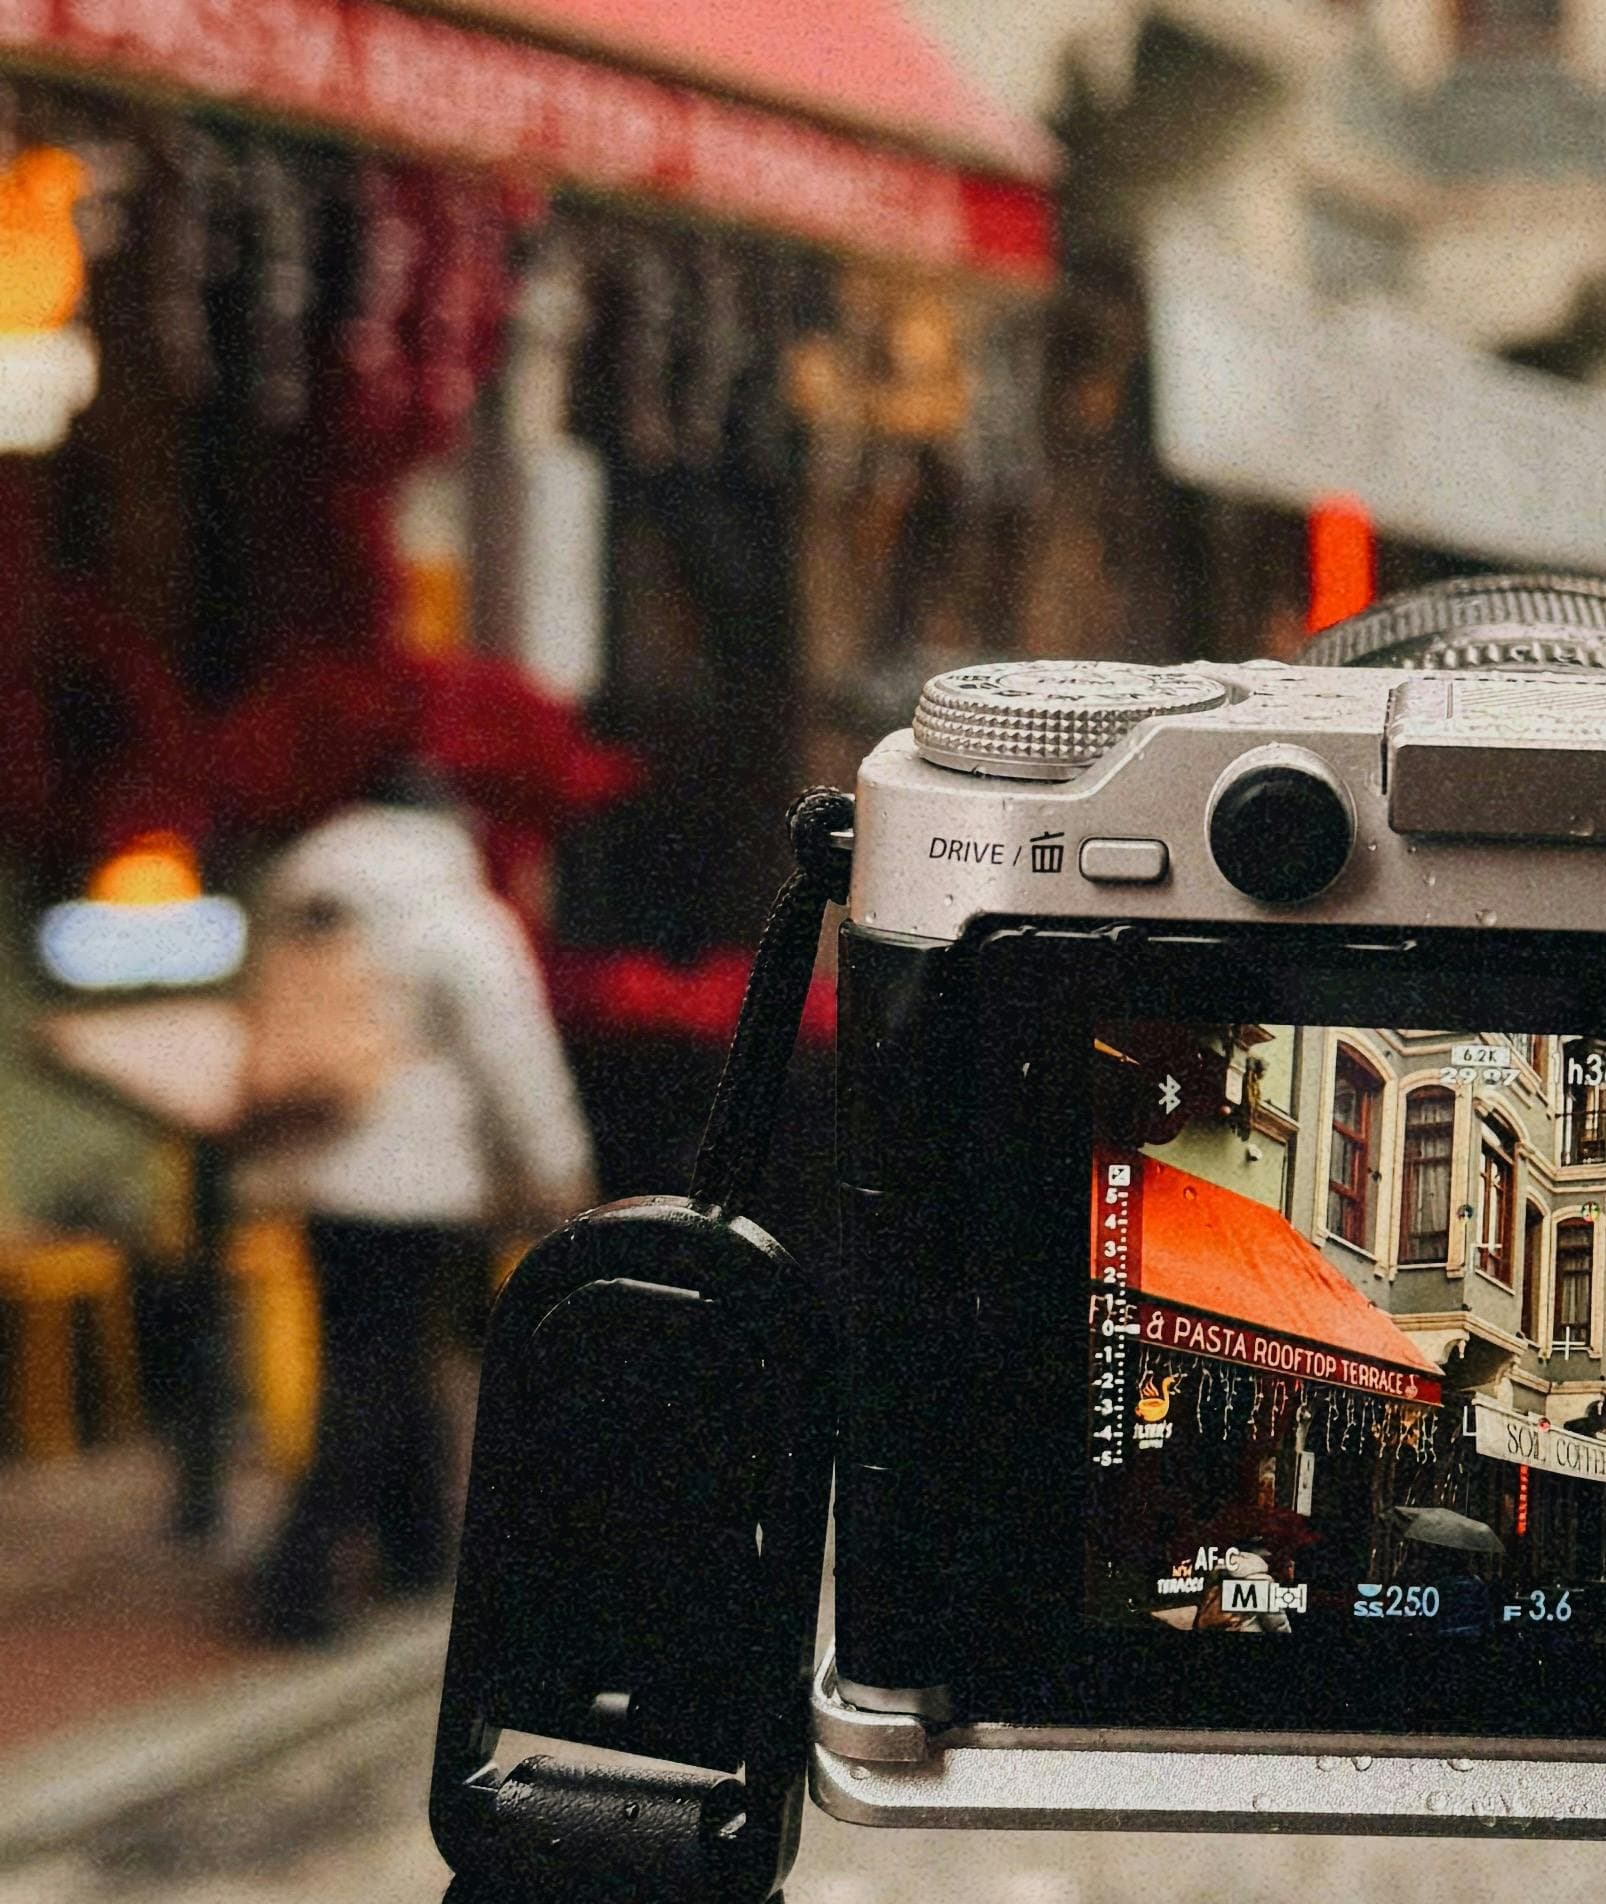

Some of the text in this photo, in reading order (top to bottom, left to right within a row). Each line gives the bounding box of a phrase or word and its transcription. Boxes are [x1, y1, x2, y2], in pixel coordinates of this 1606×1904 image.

[928, 837, 1004, 865] DRIVE
[1105, 1187, 1118, 1205] 5
[1104, 1213, 1117, 1230] 4
[1103, 1240, 1117, 1258] 3
[1103, 1266, 1117, 1284] 2
[1101, 1319, 1114, 1337] 0
[1146, 1310, 1164, 1341] &
[1173, 1316, 1248, 1360] PASTA
[1253, 1337, 1337, 1379] ROOFTOP
[1341, 1358, 1404, 1396] TERRACE
[1194, 1546, 1239, 1571] AF-C
[1231, 1583, 1258, 1609] M
[1503, 1589, 1572, 1623] F 3.6
